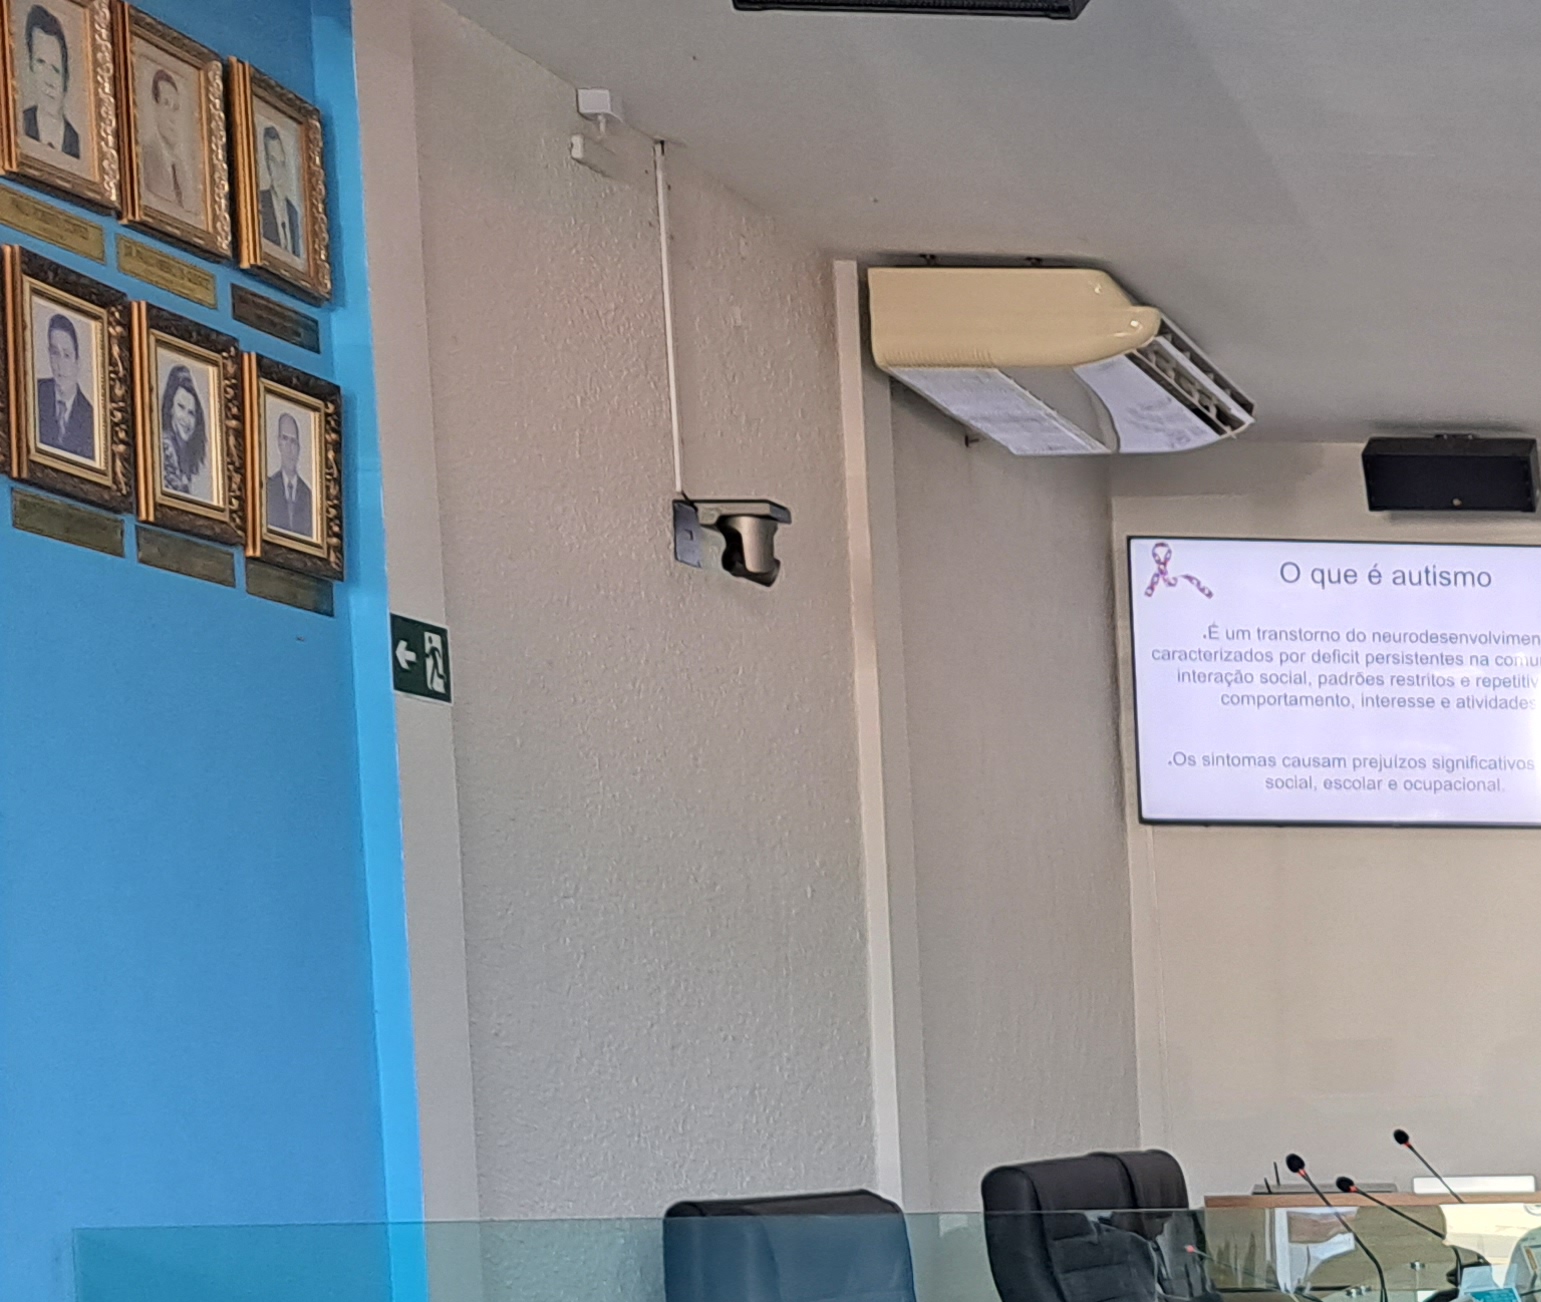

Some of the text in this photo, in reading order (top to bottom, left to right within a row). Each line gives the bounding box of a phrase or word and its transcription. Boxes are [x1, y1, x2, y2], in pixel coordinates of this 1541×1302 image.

[1279, 561, 1493, 590] O que é autismo
[1225, 628, 1251, 642] um
[1256, 627, 1341, 643] transtorno
[1345, 627, 1367, 644] do
[1151, 647, 1274, 664] caracterizados
[1279, 651, 1306, 667] por
[1311, 648, 1361, 665] deficit
[1365, 651, 1464, 668] persistentes
[1470, 654, 1490, 668] na
[1177, 668, 1539, 692] interação social, padrões restritos e repetitiv
[1220, 692, 1356, 711] comportamento,
[1360, 692, 1437, 709] interesse
[1440, 697, 1451, 709] e
[1167, 750, 1535, 774] .Os sintomas causam prejuízos significativos
[1265, 774, 1318, 792] social,
[1323, 775, 1383, 792] escolar
[1387, 780, 1398, 792] e
